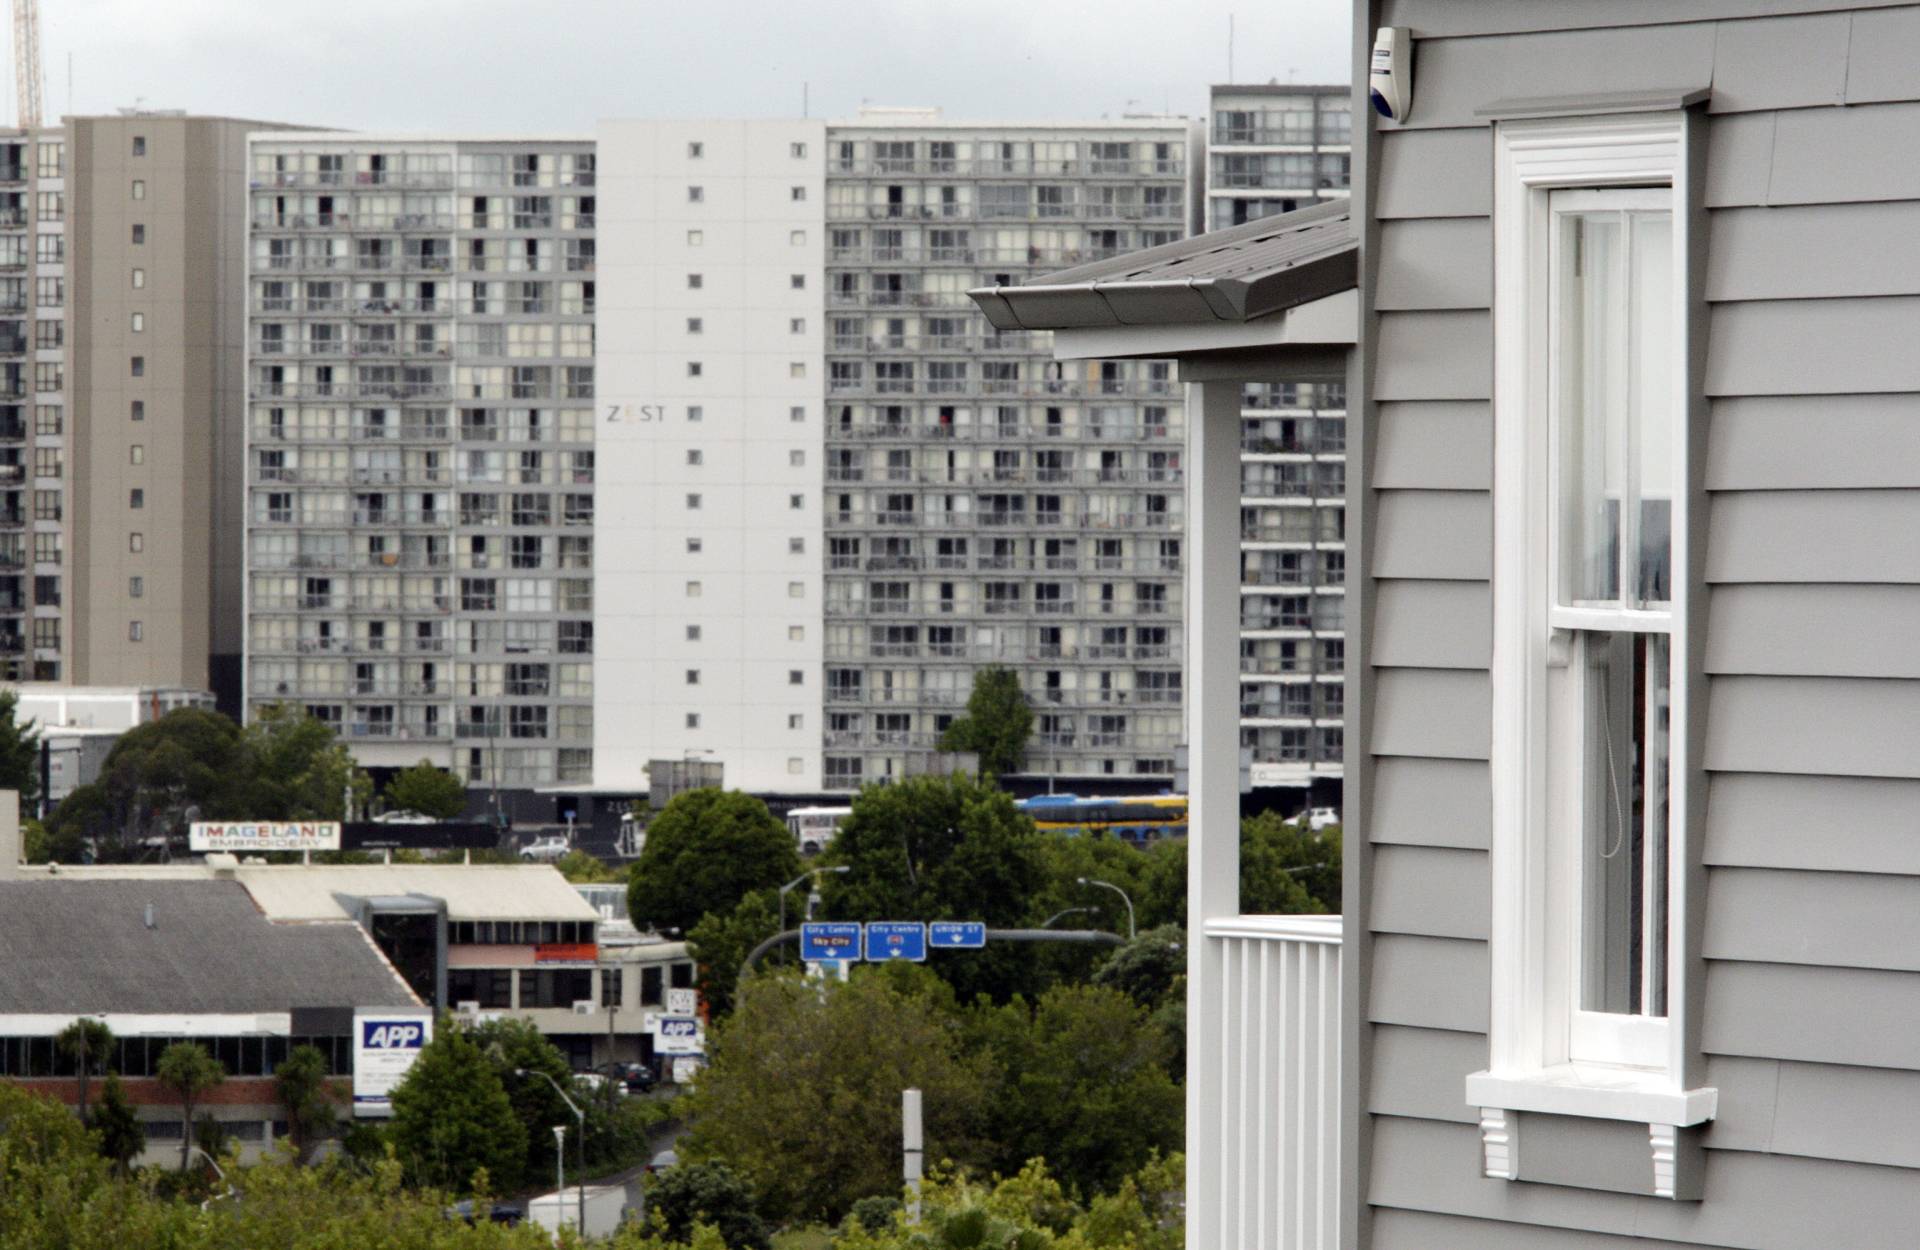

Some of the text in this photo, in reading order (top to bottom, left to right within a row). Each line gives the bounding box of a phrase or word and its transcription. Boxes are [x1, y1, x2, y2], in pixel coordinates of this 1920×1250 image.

[198, 825, 334, 837] IMAGELAND
[209, 838, 321, 848] EMBROIDERY
[806, 925, 855, 935] City Centre
[871, 925, 920, 934] City Centre
[812, 937, 850, 946] Sky City
[663, 1022, 694, 1035] APP
[369, 1026, 419, 1048] APP
